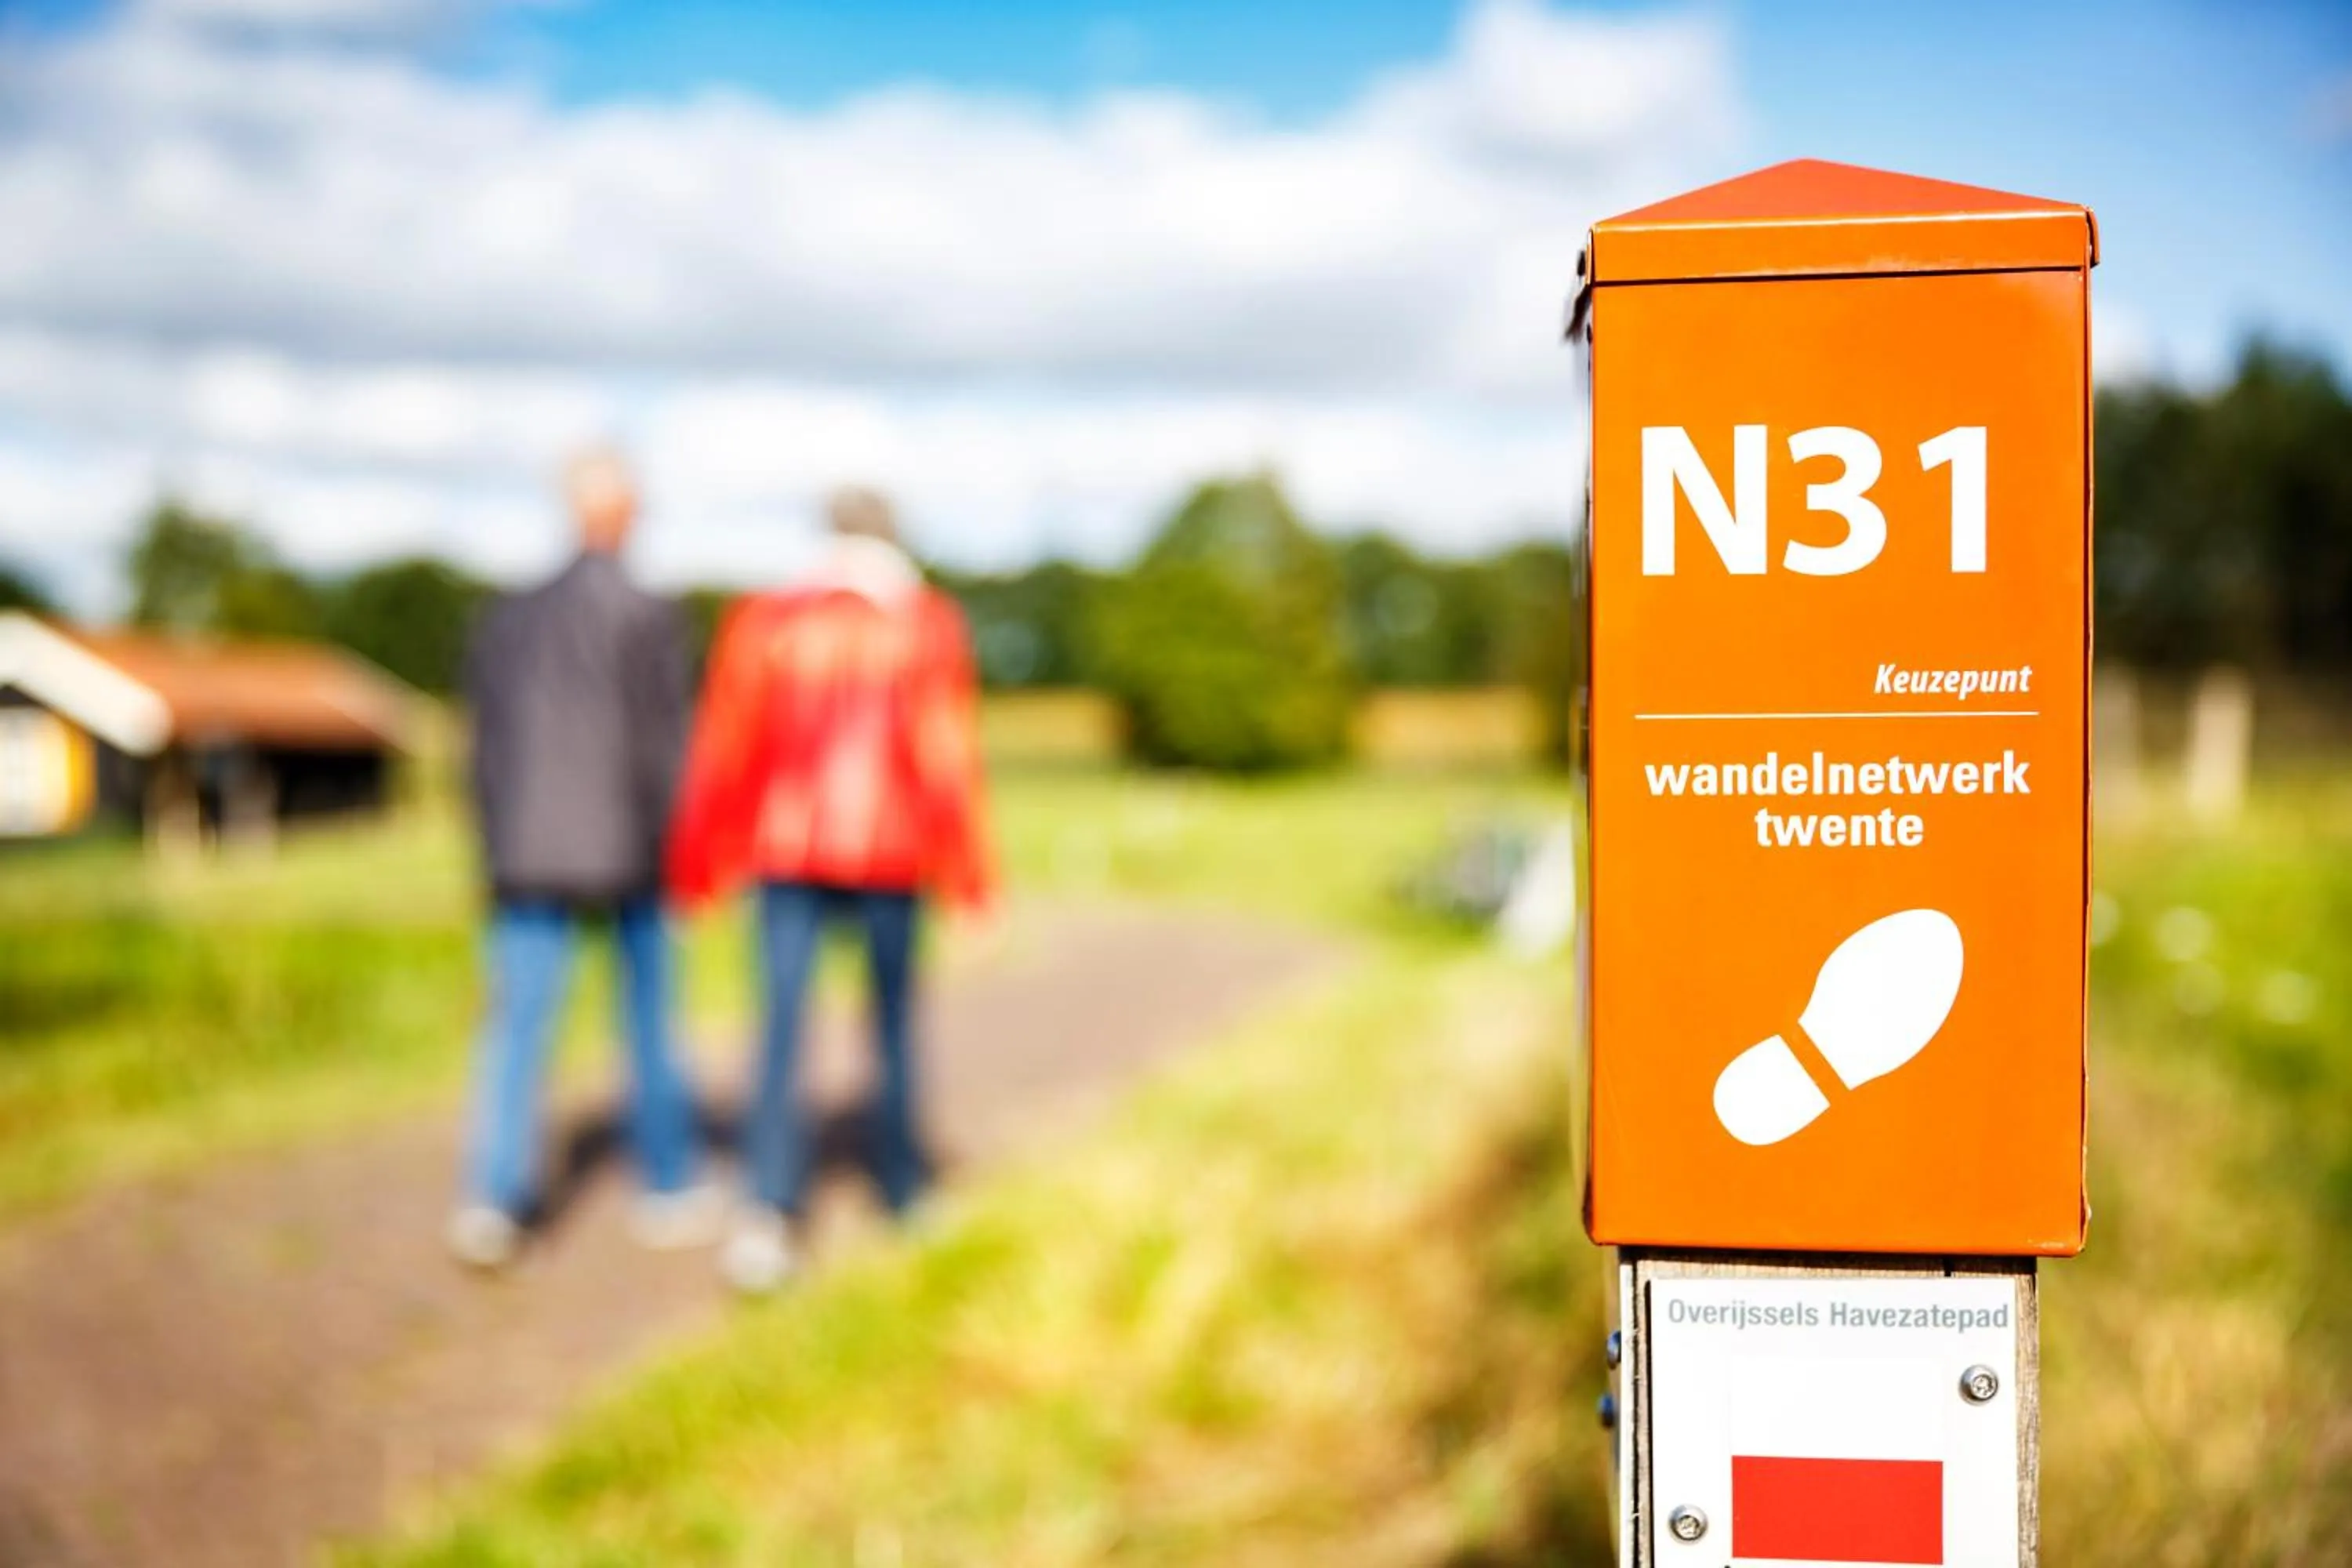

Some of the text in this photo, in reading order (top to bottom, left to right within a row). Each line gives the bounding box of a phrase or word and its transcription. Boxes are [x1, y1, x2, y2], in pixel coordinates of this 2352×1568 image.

[1641, 424, 1987, 576] N31
[1874, 664, 2033, 700] Keuzepunt
[1644, 750, 2031, 796] wandelnetwerk
[1754, 808, 1924, 847] twente
[1668, 1298, 2009, 1334] Overijssels Havezatepad
